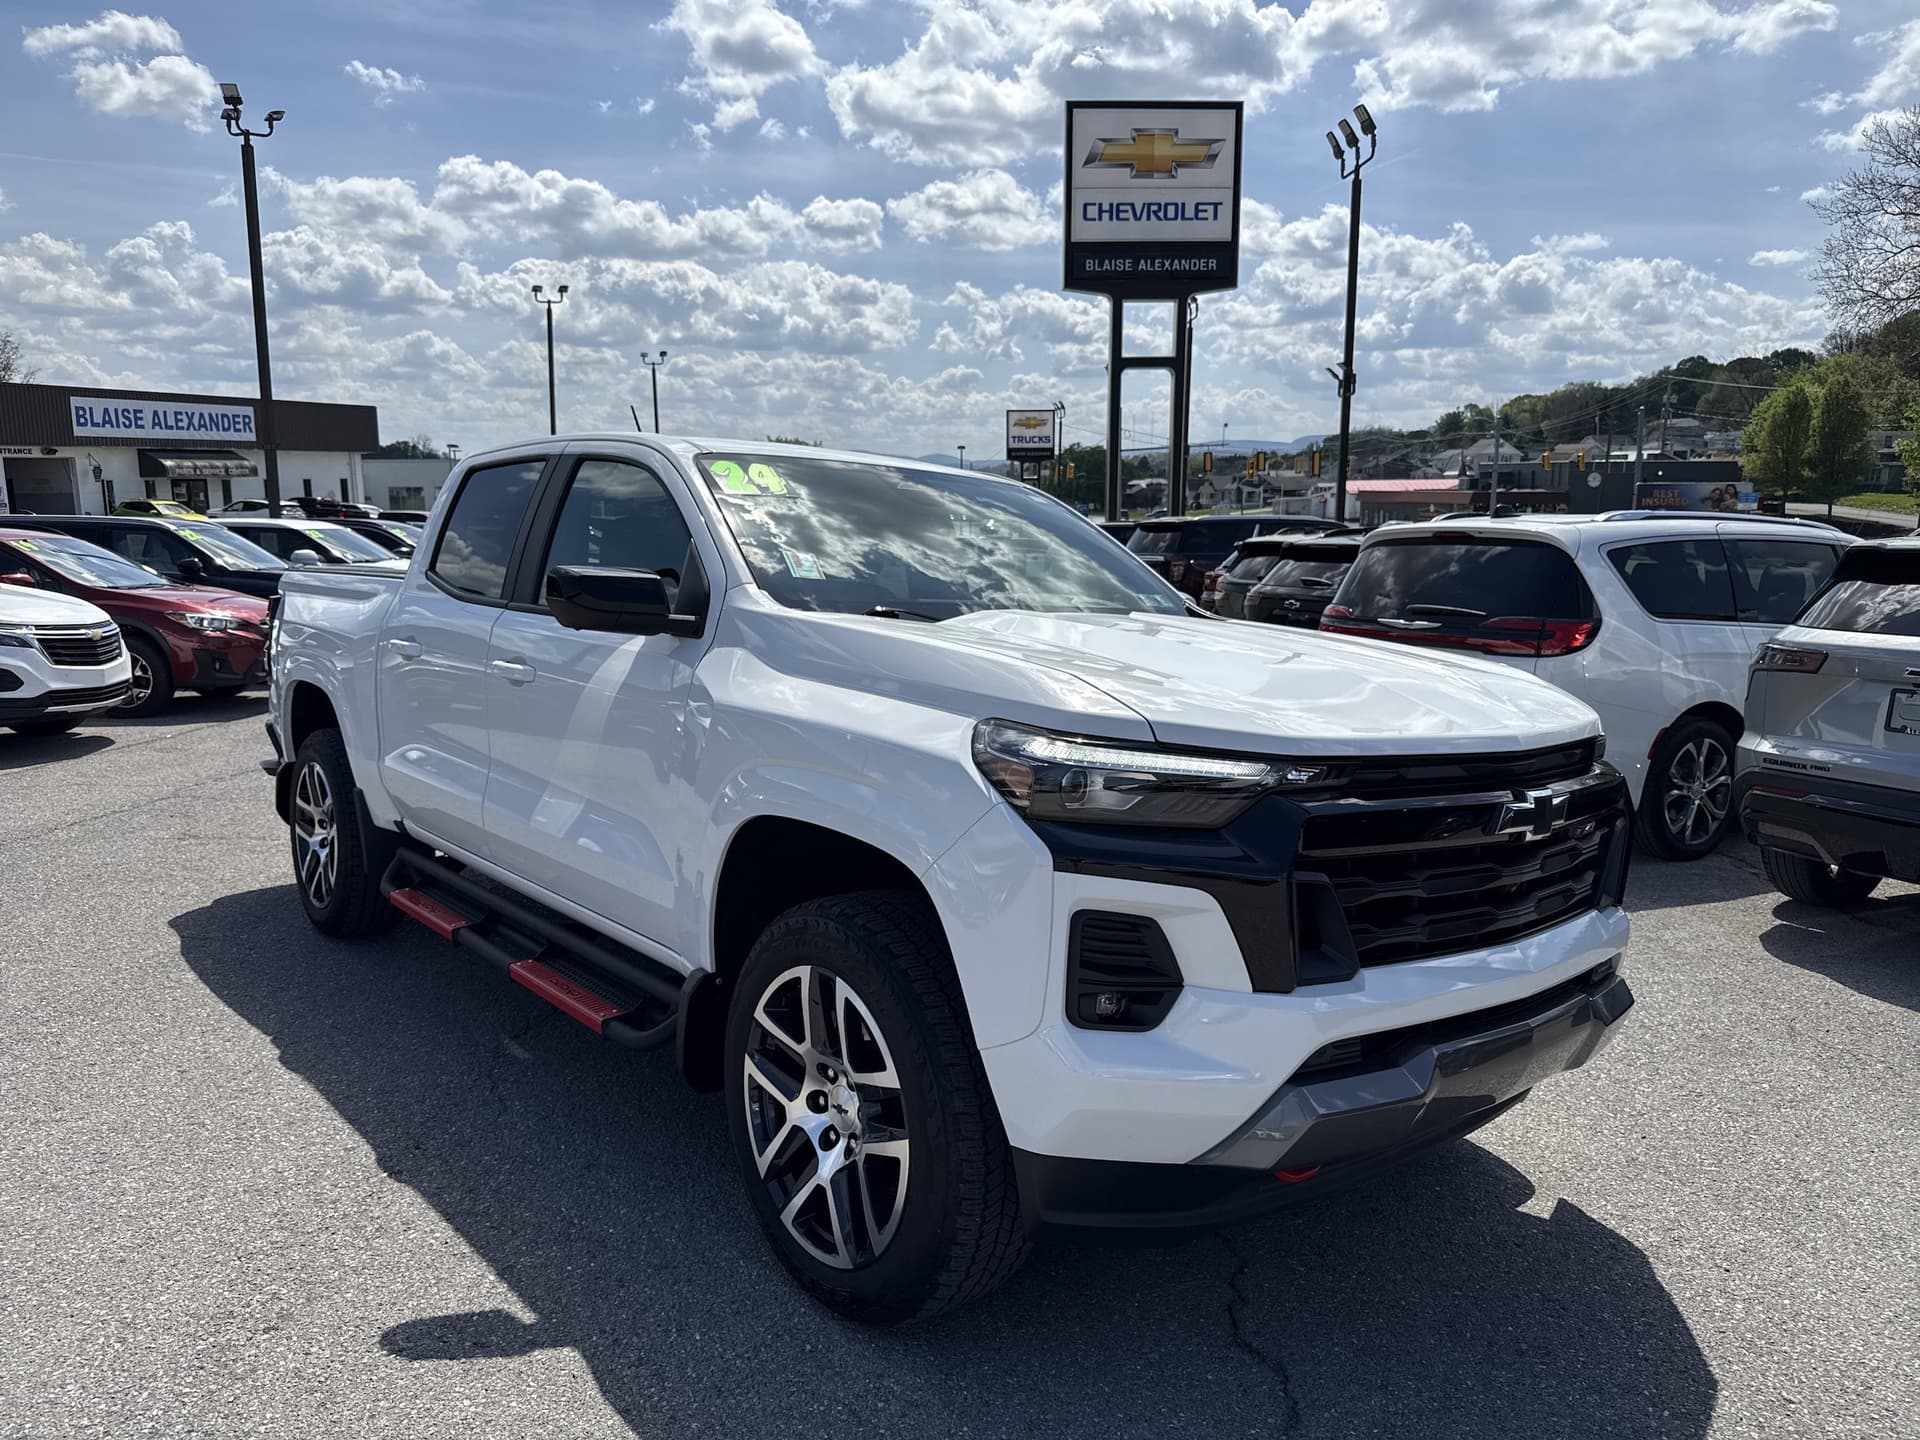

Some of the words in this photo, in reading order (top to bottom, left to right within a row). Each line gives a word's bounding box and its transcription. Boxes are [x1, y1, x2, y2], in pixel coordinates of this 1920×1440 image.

[1082, 201, 1223, 222] CHEVROLET
[1085, 259, 1133, 271] BLAISE
[1138, 259, 1217, 271] ALEXANDER
[74, 406, 145, 429] BLAISE
[151, 410, 254, 433] ALEXANDER
[1011, 435, 1051, 444] TRUCKS
[710, 461, 788, 494] 24
[1641, 497, 1689, 507] INSURED
[1763, 757, 1808, 770] EQUINOX
